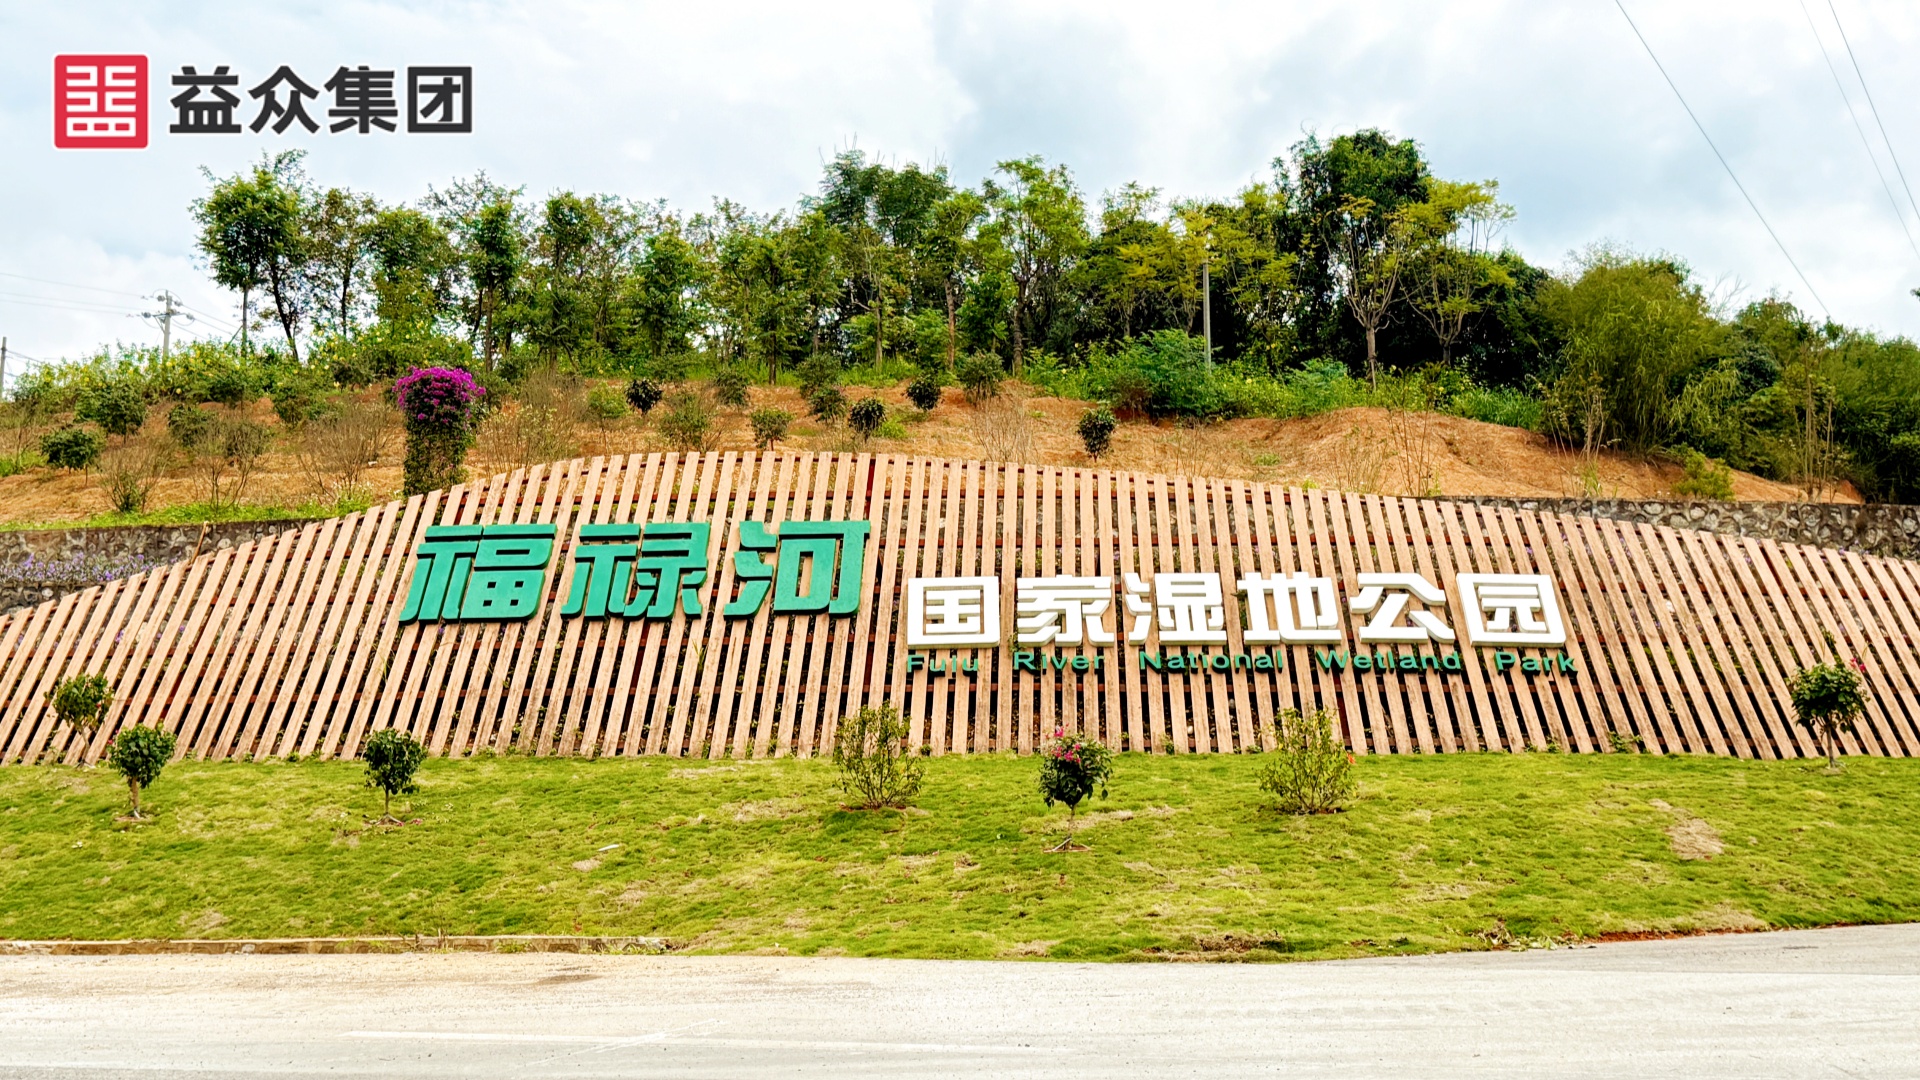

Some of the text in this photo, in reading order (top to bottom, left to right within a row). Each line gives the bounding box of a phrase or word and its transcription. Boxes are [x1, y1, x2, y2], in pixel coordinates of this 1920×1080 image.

[400, 520, 871, 623] 福禄河
[906, 571, 1567, 648] 国家湿地公园
[1013, 650, 1105, 672] River
[1139, 650, 1284, 670] National
[1316, 650, 1461, 672] Wetland
[1494, 651, 1577, 673] Park
